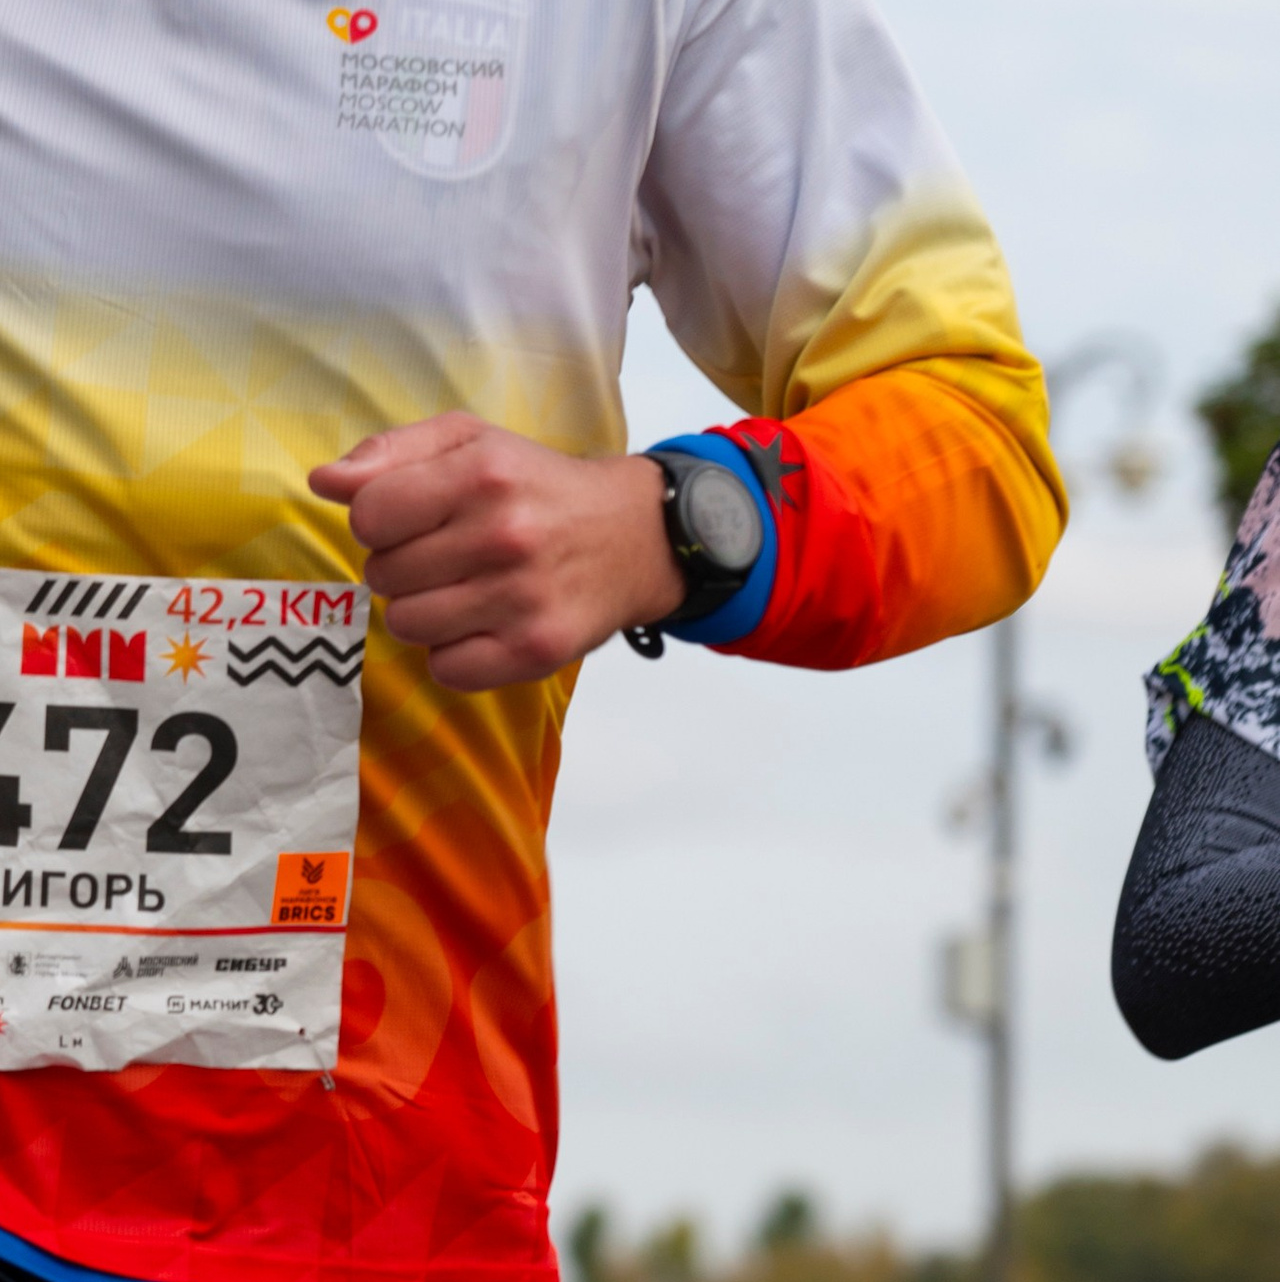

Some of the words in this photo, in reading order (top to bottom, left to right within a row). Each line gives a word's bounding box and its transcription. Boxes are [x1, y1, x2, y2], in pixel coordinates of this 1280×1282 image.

[340, 51, 505, 80] МОСКОВСКИЙ
[339, 71, 458, 97] МАРАФОН
[338, 91, 444, 116] MOSCOW
[336, 110, 467, 139] MARATHON
[166, 585, 267, 630] 42,2
[1, 868, 166, 913] ИГОРЬ
[278, 905, 336, 922] BRICS
[138, 953, 200, 967] МОСКОВСКИЙ
[215, 957, 288, 973] СИБУР
[47, 995, 129, 1012] FONBET
[190, 999, 251, 1011] МАГНИТ
